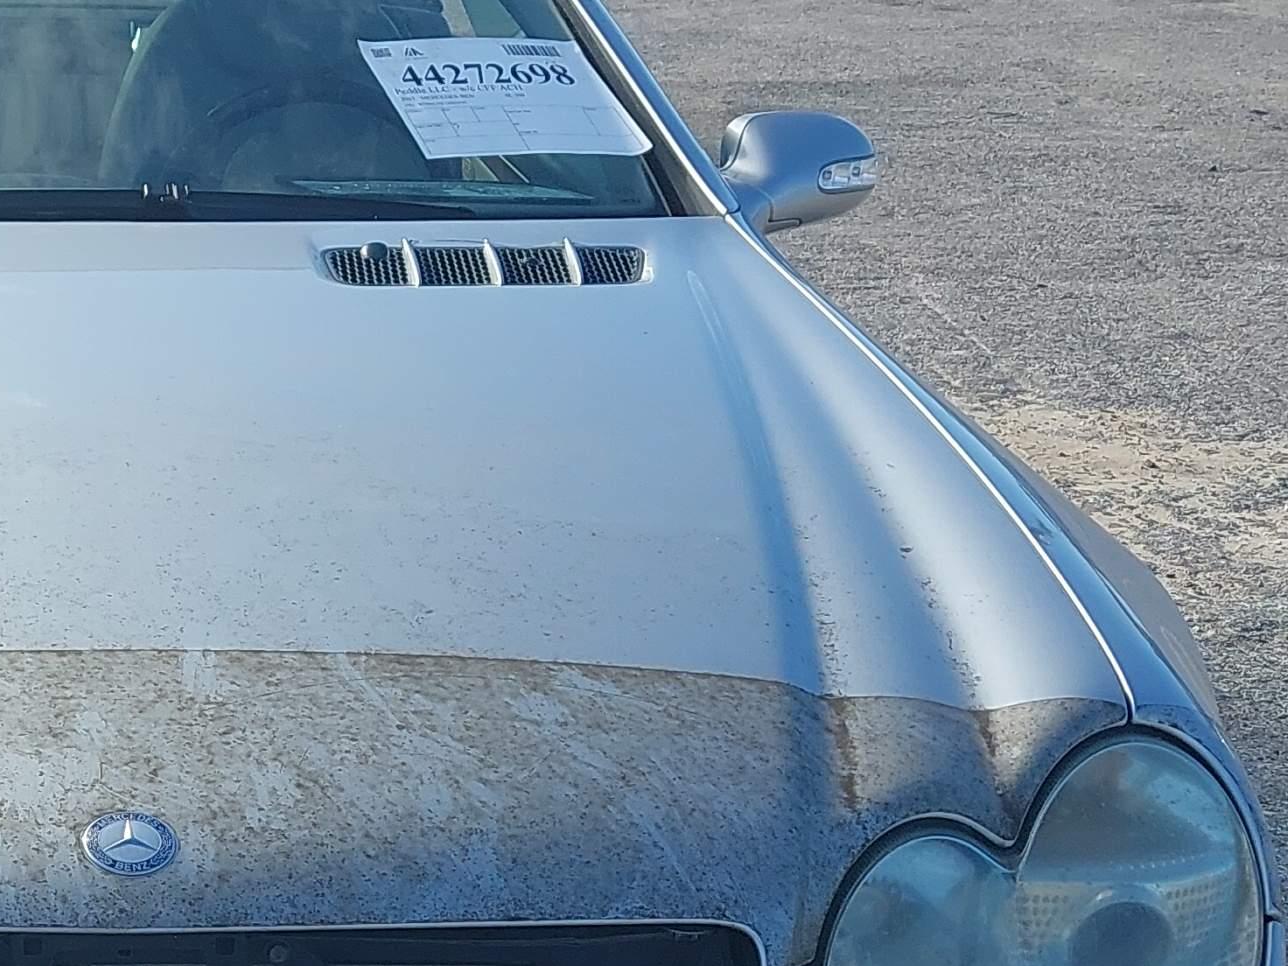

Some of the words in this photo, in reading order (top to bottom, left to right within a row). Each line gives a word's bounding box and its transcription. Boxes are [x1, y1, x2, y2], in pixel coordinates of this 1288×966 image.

[402, 63, 576, 86] 44272698
[97, 813, 159, 827] MERCEDES
[114, 862, 151, 872] BENZ
